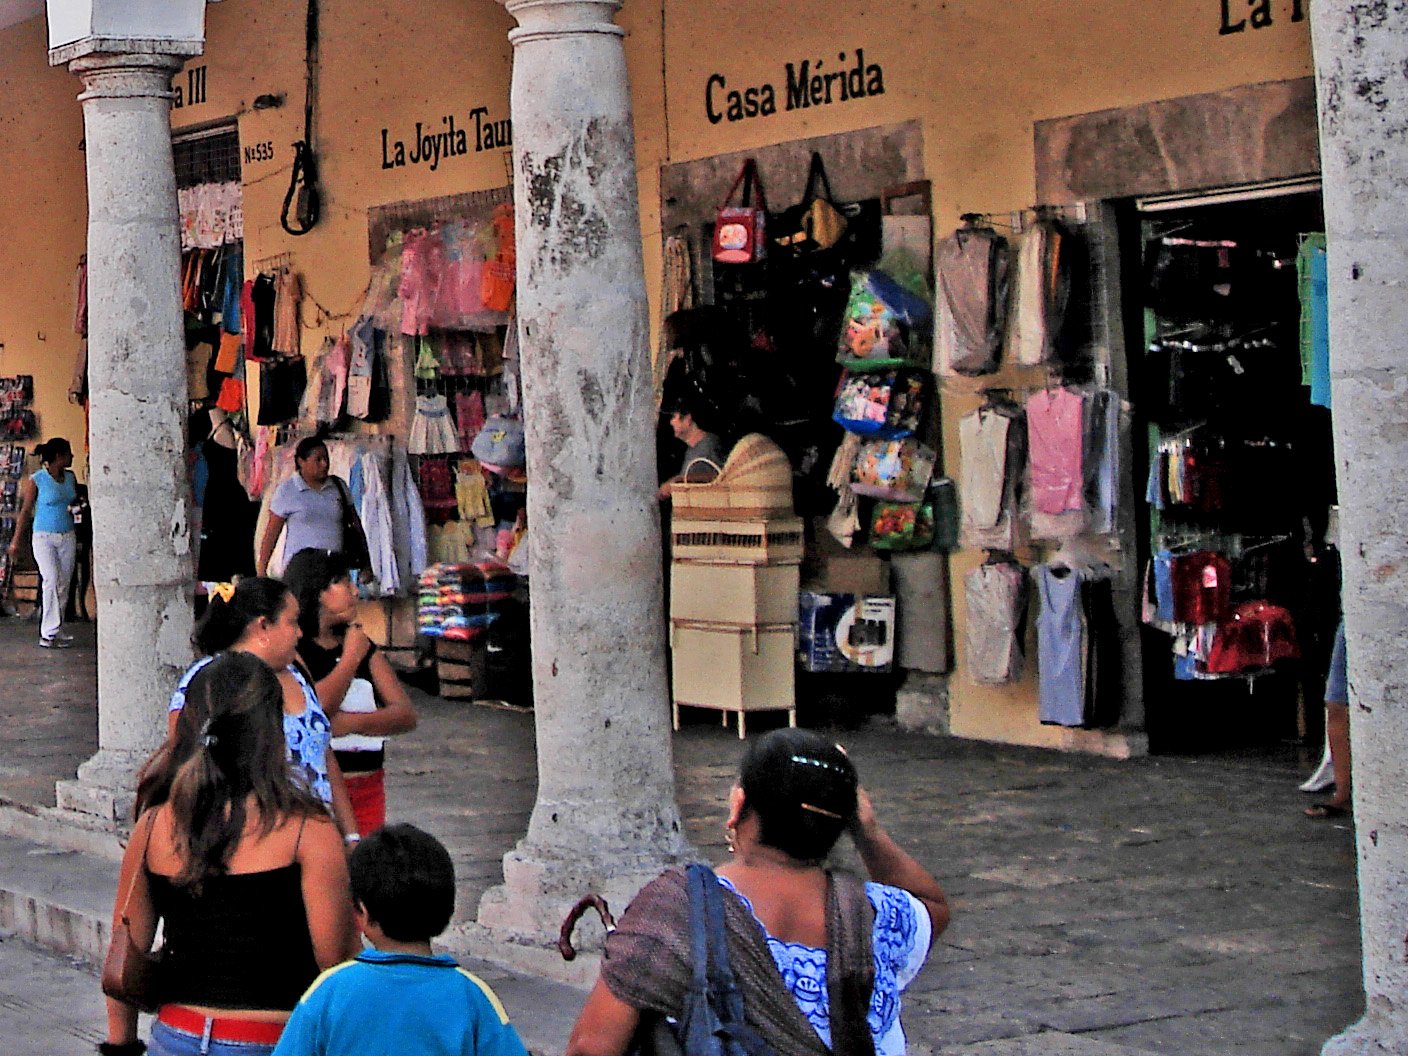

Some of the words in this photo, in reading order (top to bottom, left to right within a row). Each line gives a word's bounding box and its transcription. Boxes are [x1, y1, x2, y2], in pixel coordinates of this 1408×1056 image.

[188, 65, 207, 106] III
[705, 73, 777, 125] Casa
[785, 48, 886, 112] Mérida
[381, 128, 406, 170] La
[409, 115, 468, 172] Joyita
